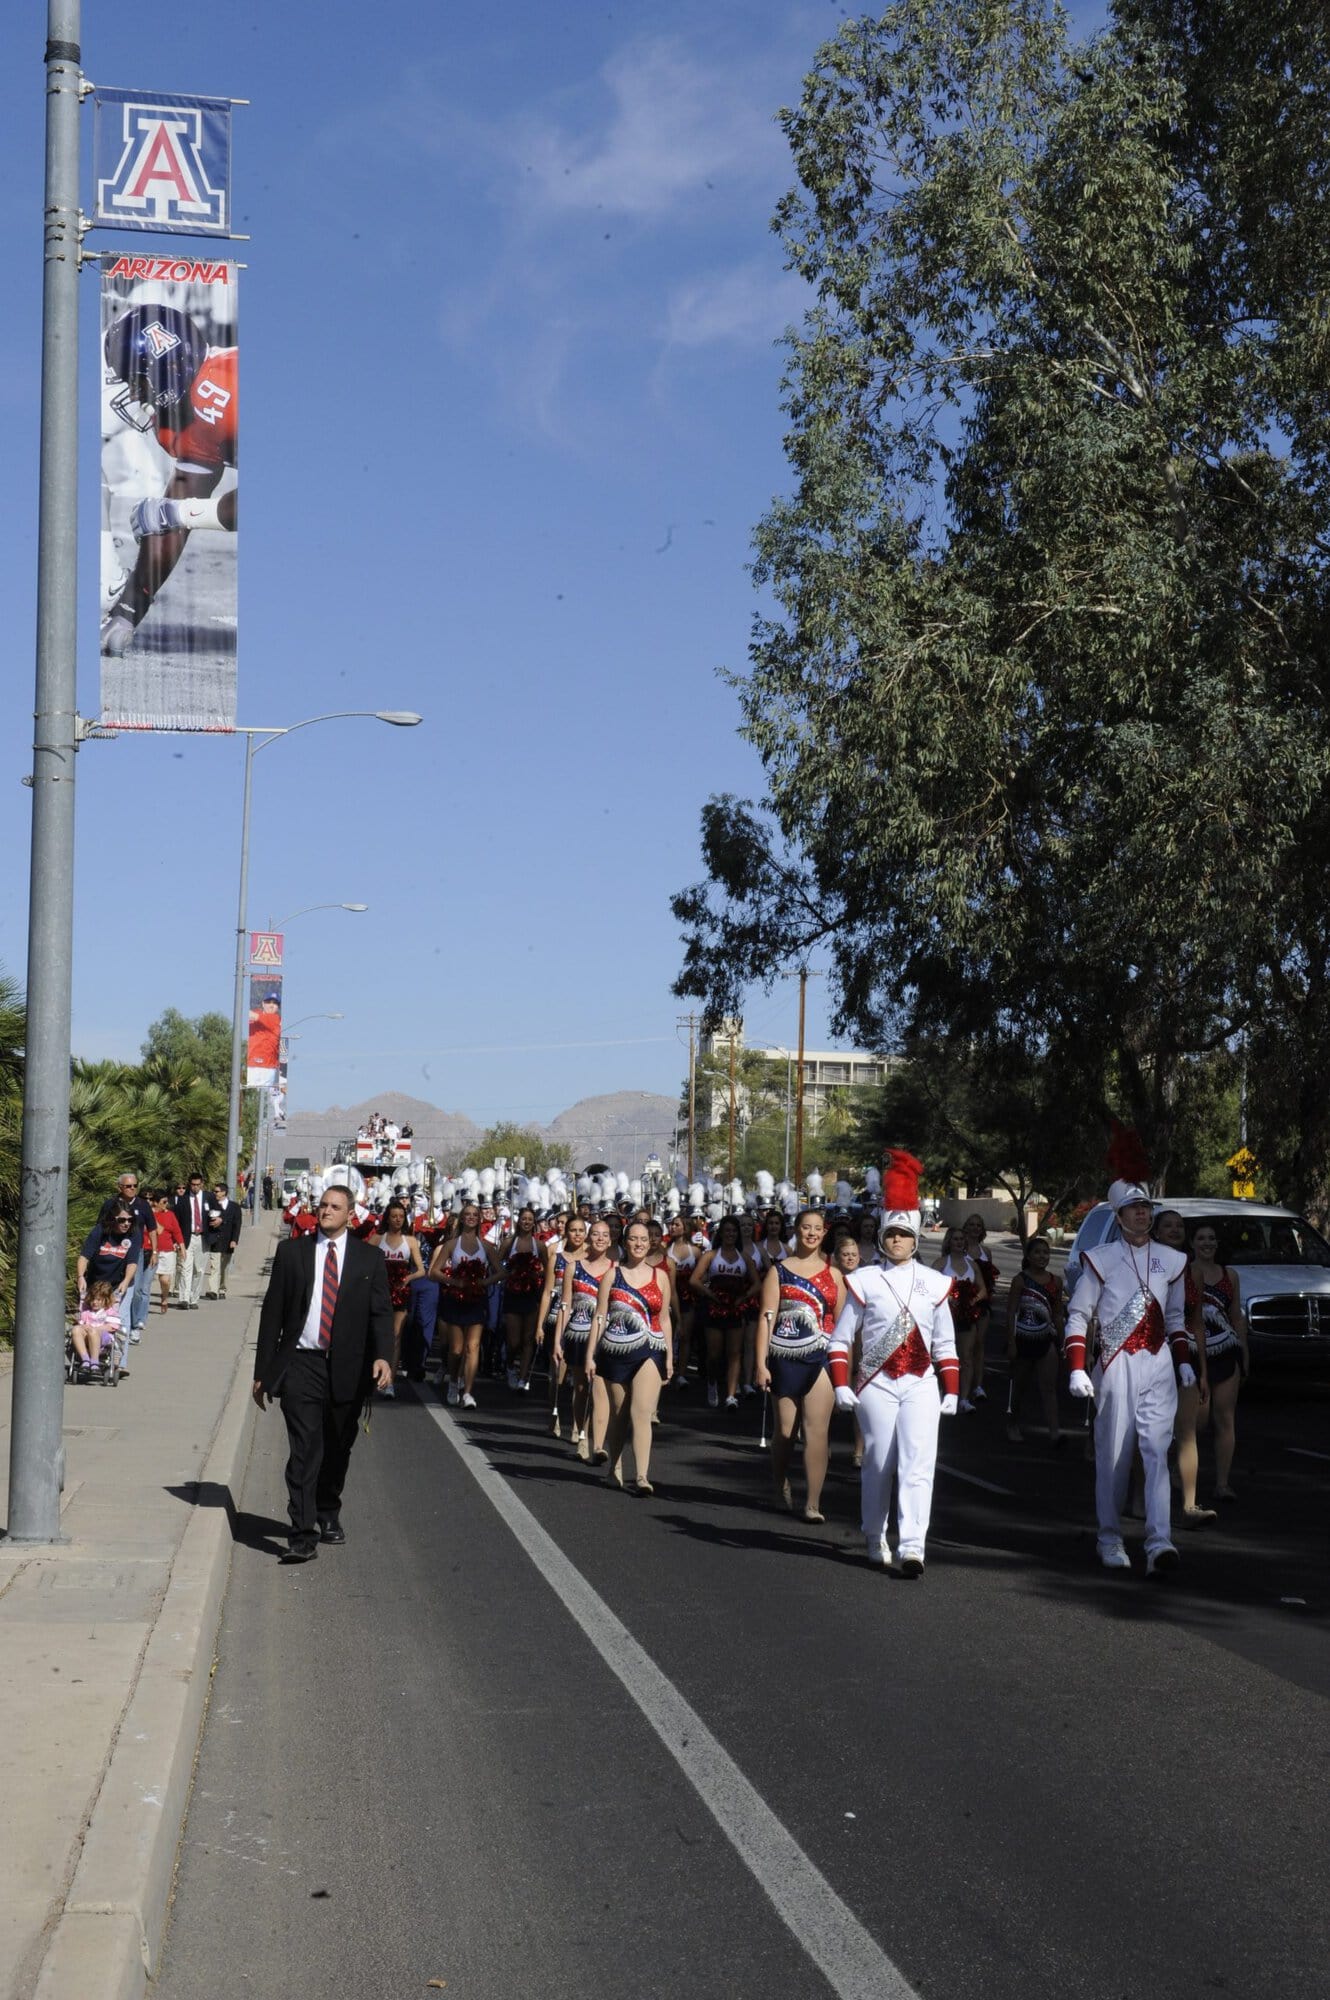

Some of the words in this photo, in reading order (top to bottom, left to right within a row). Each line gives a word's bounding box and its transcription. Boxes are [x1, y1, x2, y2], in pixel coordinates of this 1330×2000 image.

[98, 102, 225, 229] A
[107, 256, 229, 285] ARIZONA
[141, 321, 181, 359] A
[194, 380, 231, 425] 49
[251, 935, 282, 966] A
